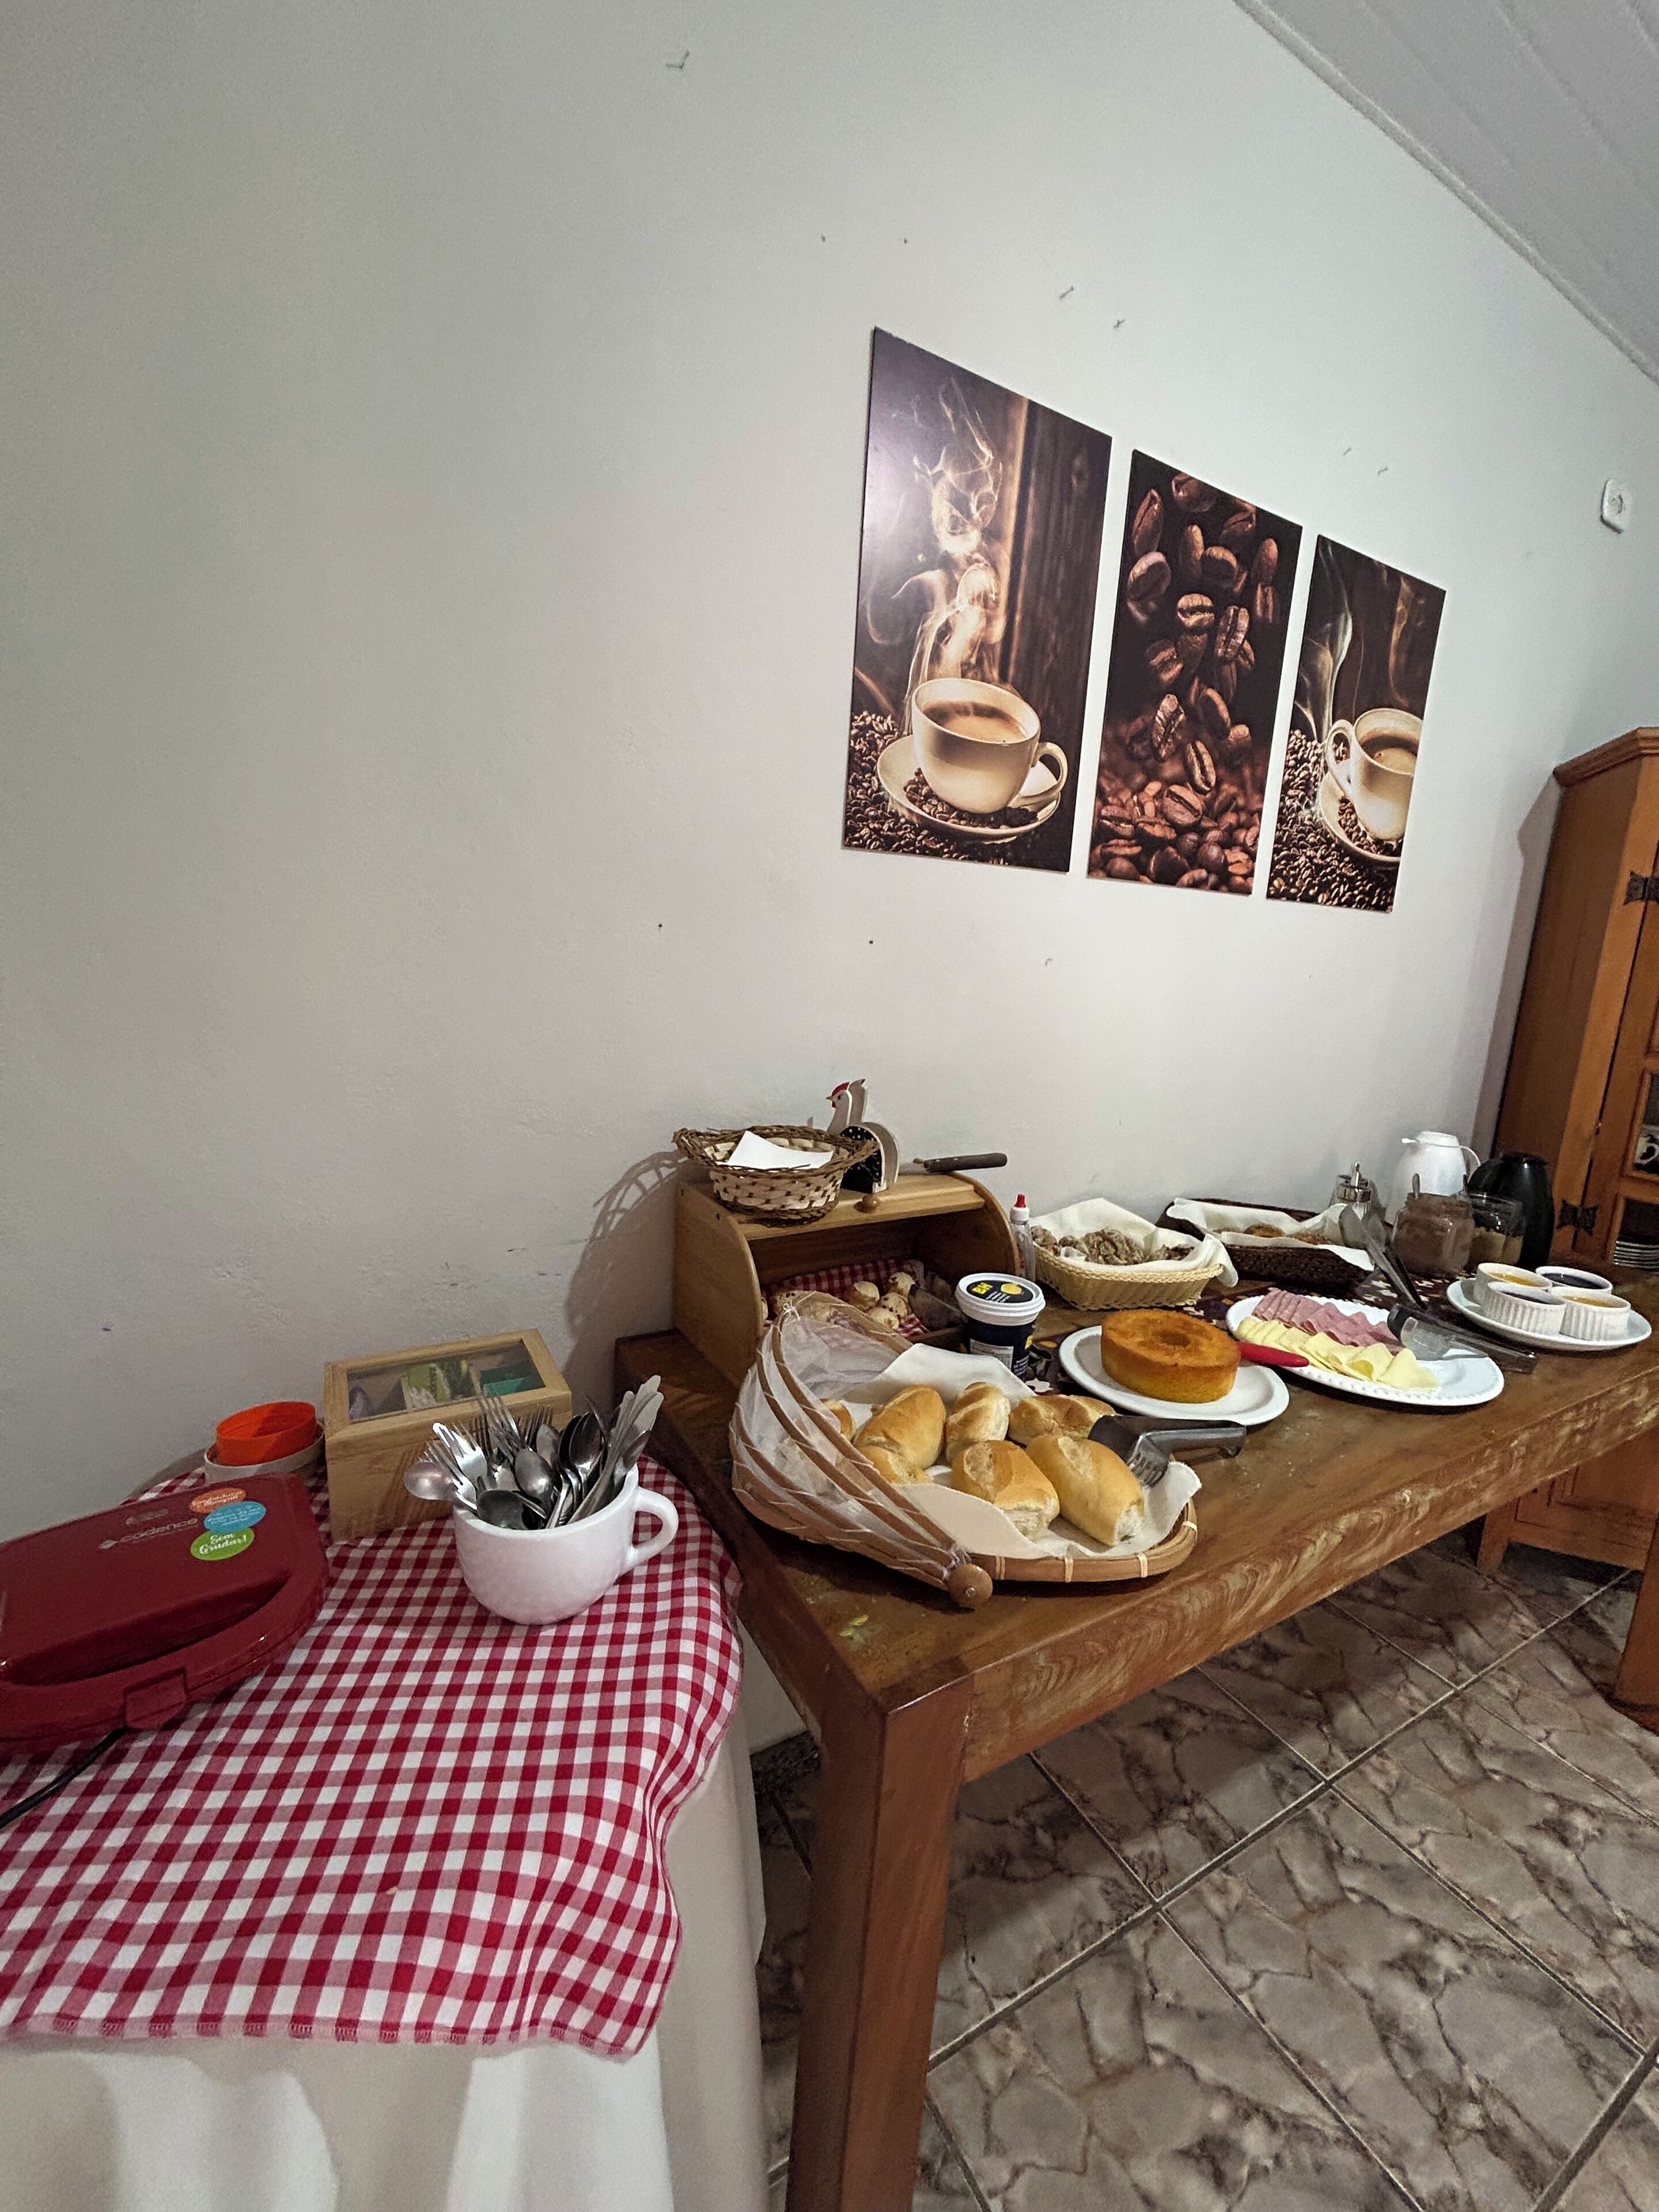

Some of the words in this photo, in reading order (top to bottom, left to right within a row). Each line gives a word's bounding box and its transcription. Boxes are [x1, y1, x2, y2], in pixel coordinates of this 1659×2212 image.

[120, 1518, 198, 1543] cadence
[210, 1533, 236, 1544] Sem
[199, 1535, 247, 1555] Grudar!
